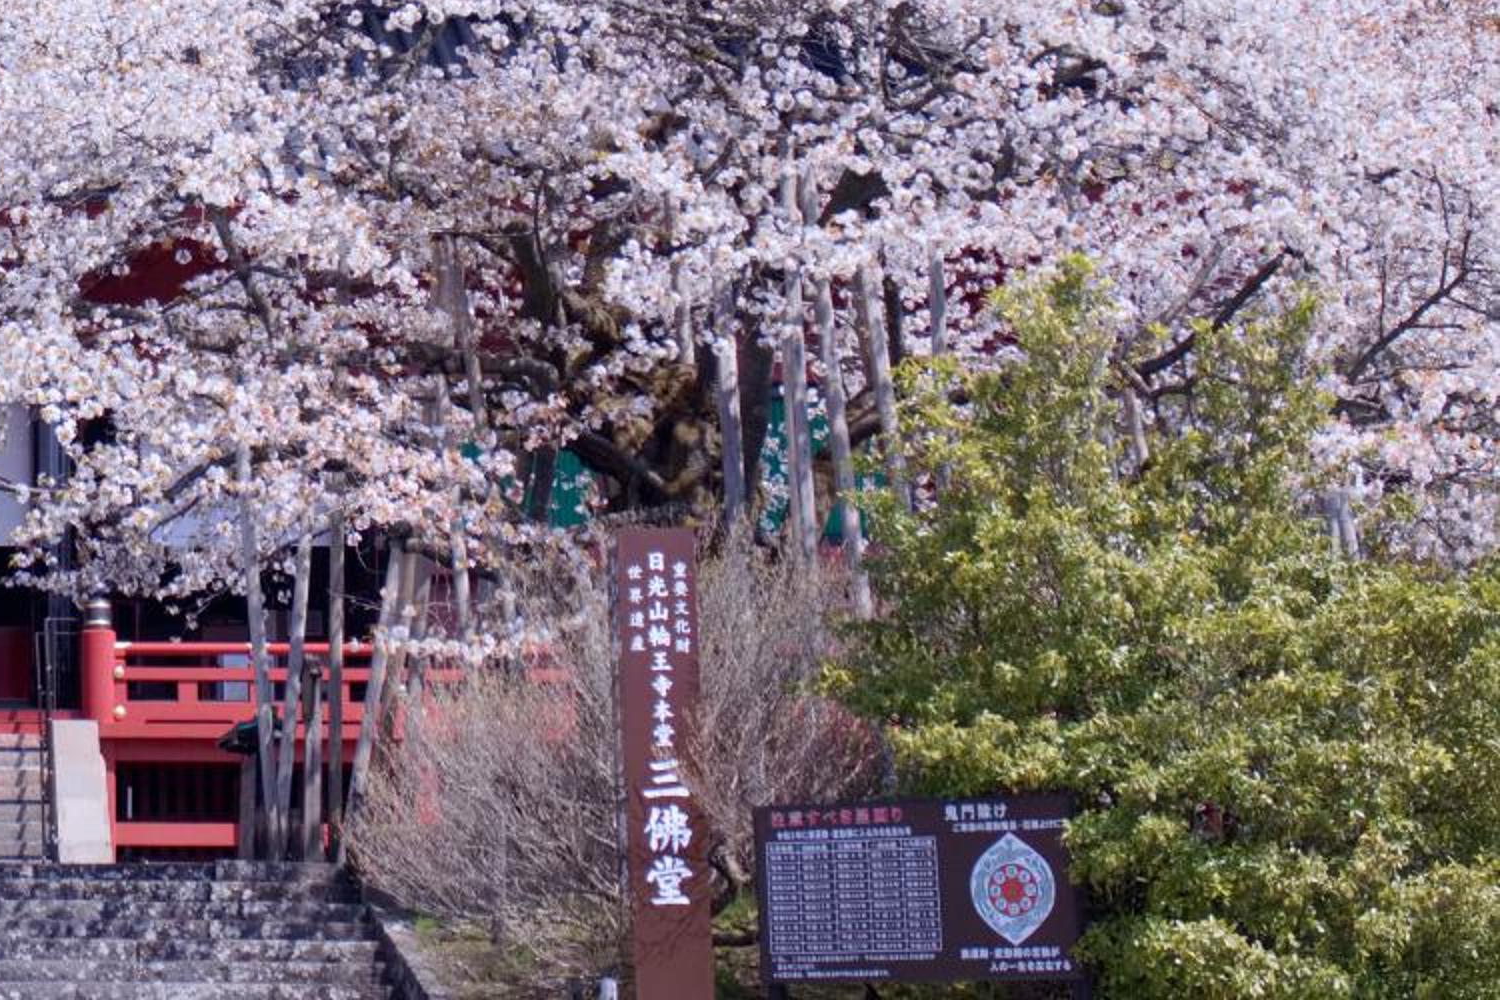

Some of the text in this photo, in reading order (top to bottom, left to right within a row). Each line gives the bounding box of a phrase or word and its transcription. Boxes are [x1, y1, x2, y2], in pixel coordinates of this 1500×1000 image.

[647, 552, 675, 747] 日光山輪王寺本堂
[673, 562, 691, 654] 重要文化財
[643, 758, 693, 905] 三佛堂
